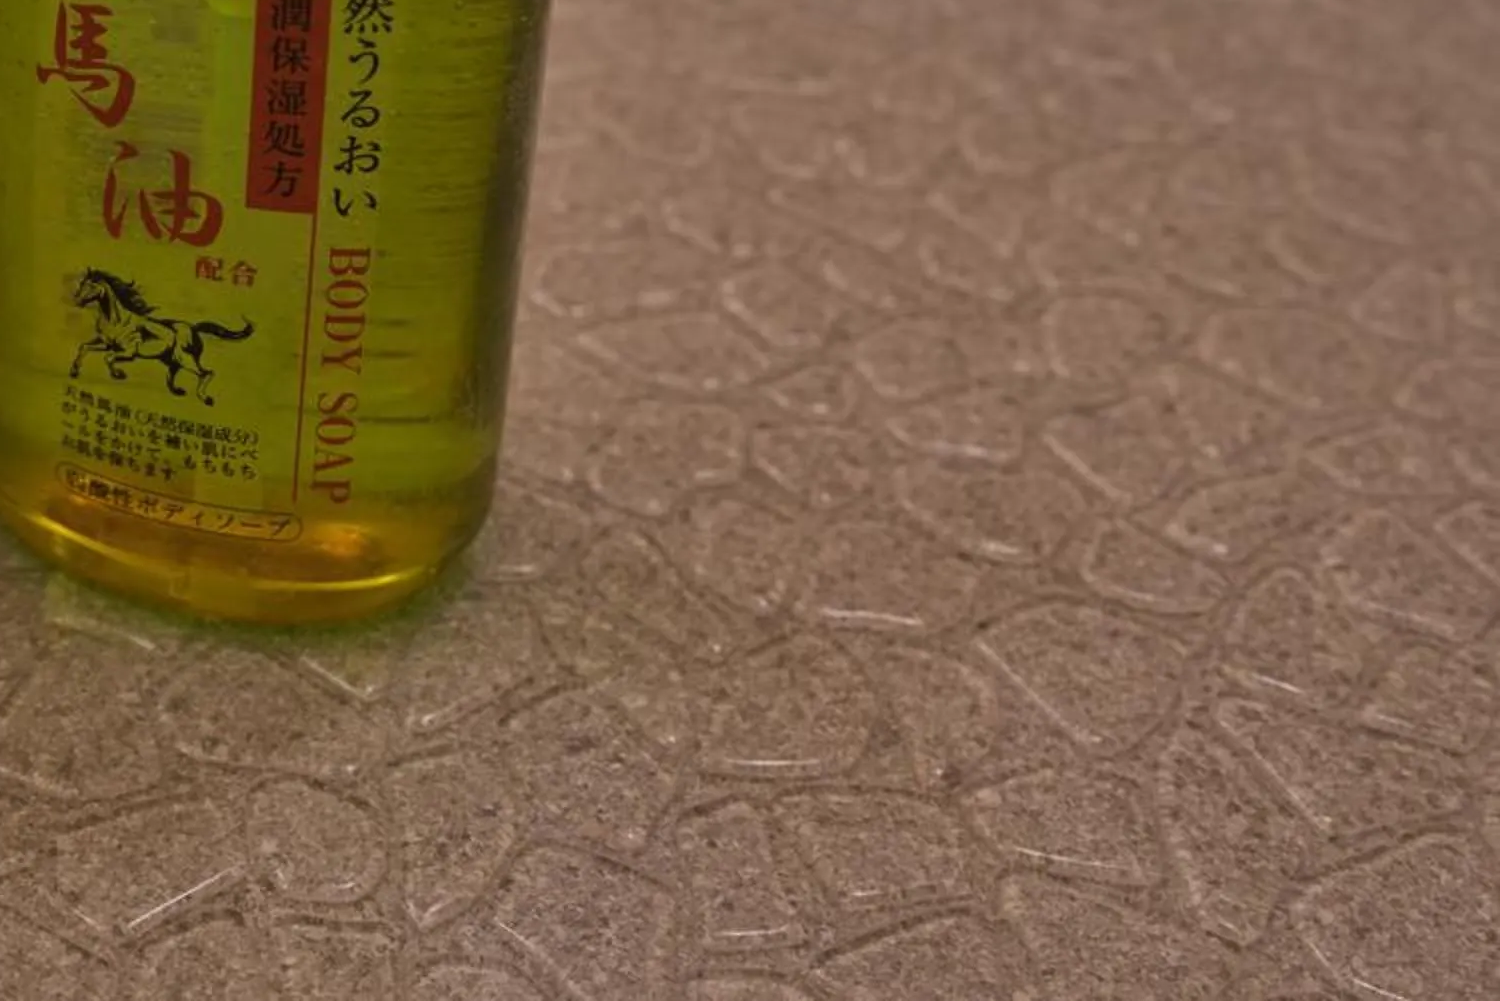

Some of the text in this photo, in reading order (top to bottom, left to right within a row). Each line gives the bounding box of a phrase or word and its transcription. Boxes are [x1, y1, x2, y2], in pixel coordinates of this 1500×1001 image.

[36, 0, 225, 248] 馬油
[195, 255, 258, 288] 配合
[321, 246, 372, 376] BODY
[310, 391, 360, 507] SOAP
